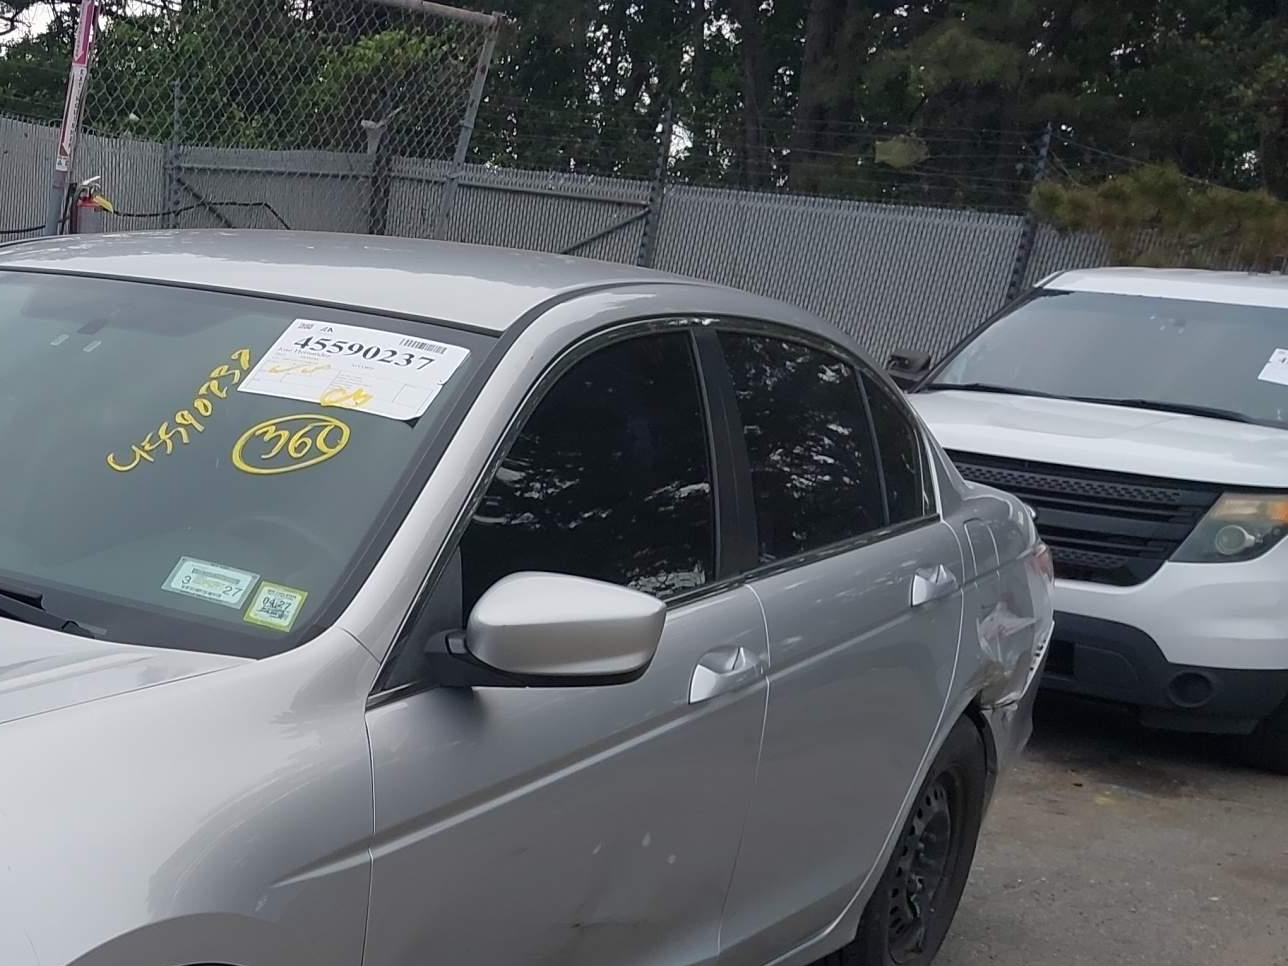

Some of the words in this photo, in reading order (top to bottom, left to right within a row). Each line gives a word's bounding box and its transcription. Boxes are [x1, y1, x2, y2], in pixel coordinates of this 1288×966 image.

[294, 335, 435, 370] 45590237
[254, 422, 349, 459] 360
[222, 584, 243, 597] 27
